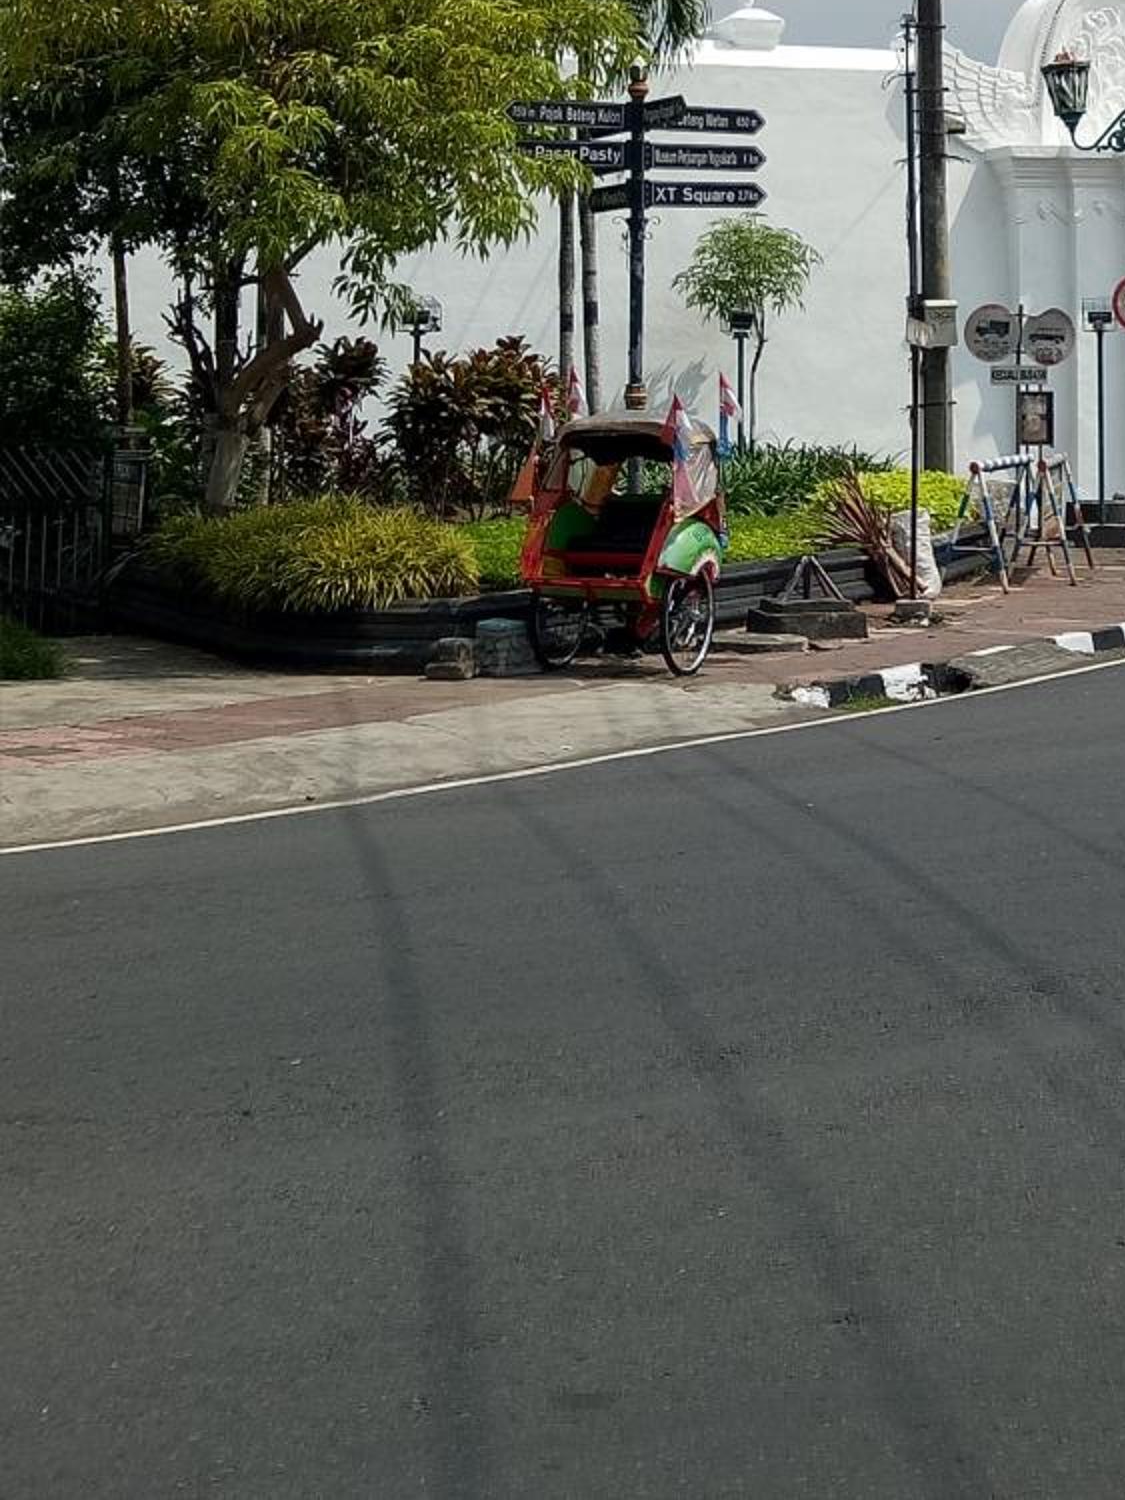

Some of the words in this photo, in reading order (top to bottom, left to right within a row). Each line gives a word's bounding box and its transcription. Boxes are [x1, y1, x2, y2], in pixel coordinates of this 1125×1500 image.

[535, 145, 577, 161] Pasar
[580, 146, 621, 164] Pasty
[655, 187, 677, 202] XT
[683, 187, 735, 204] Square
